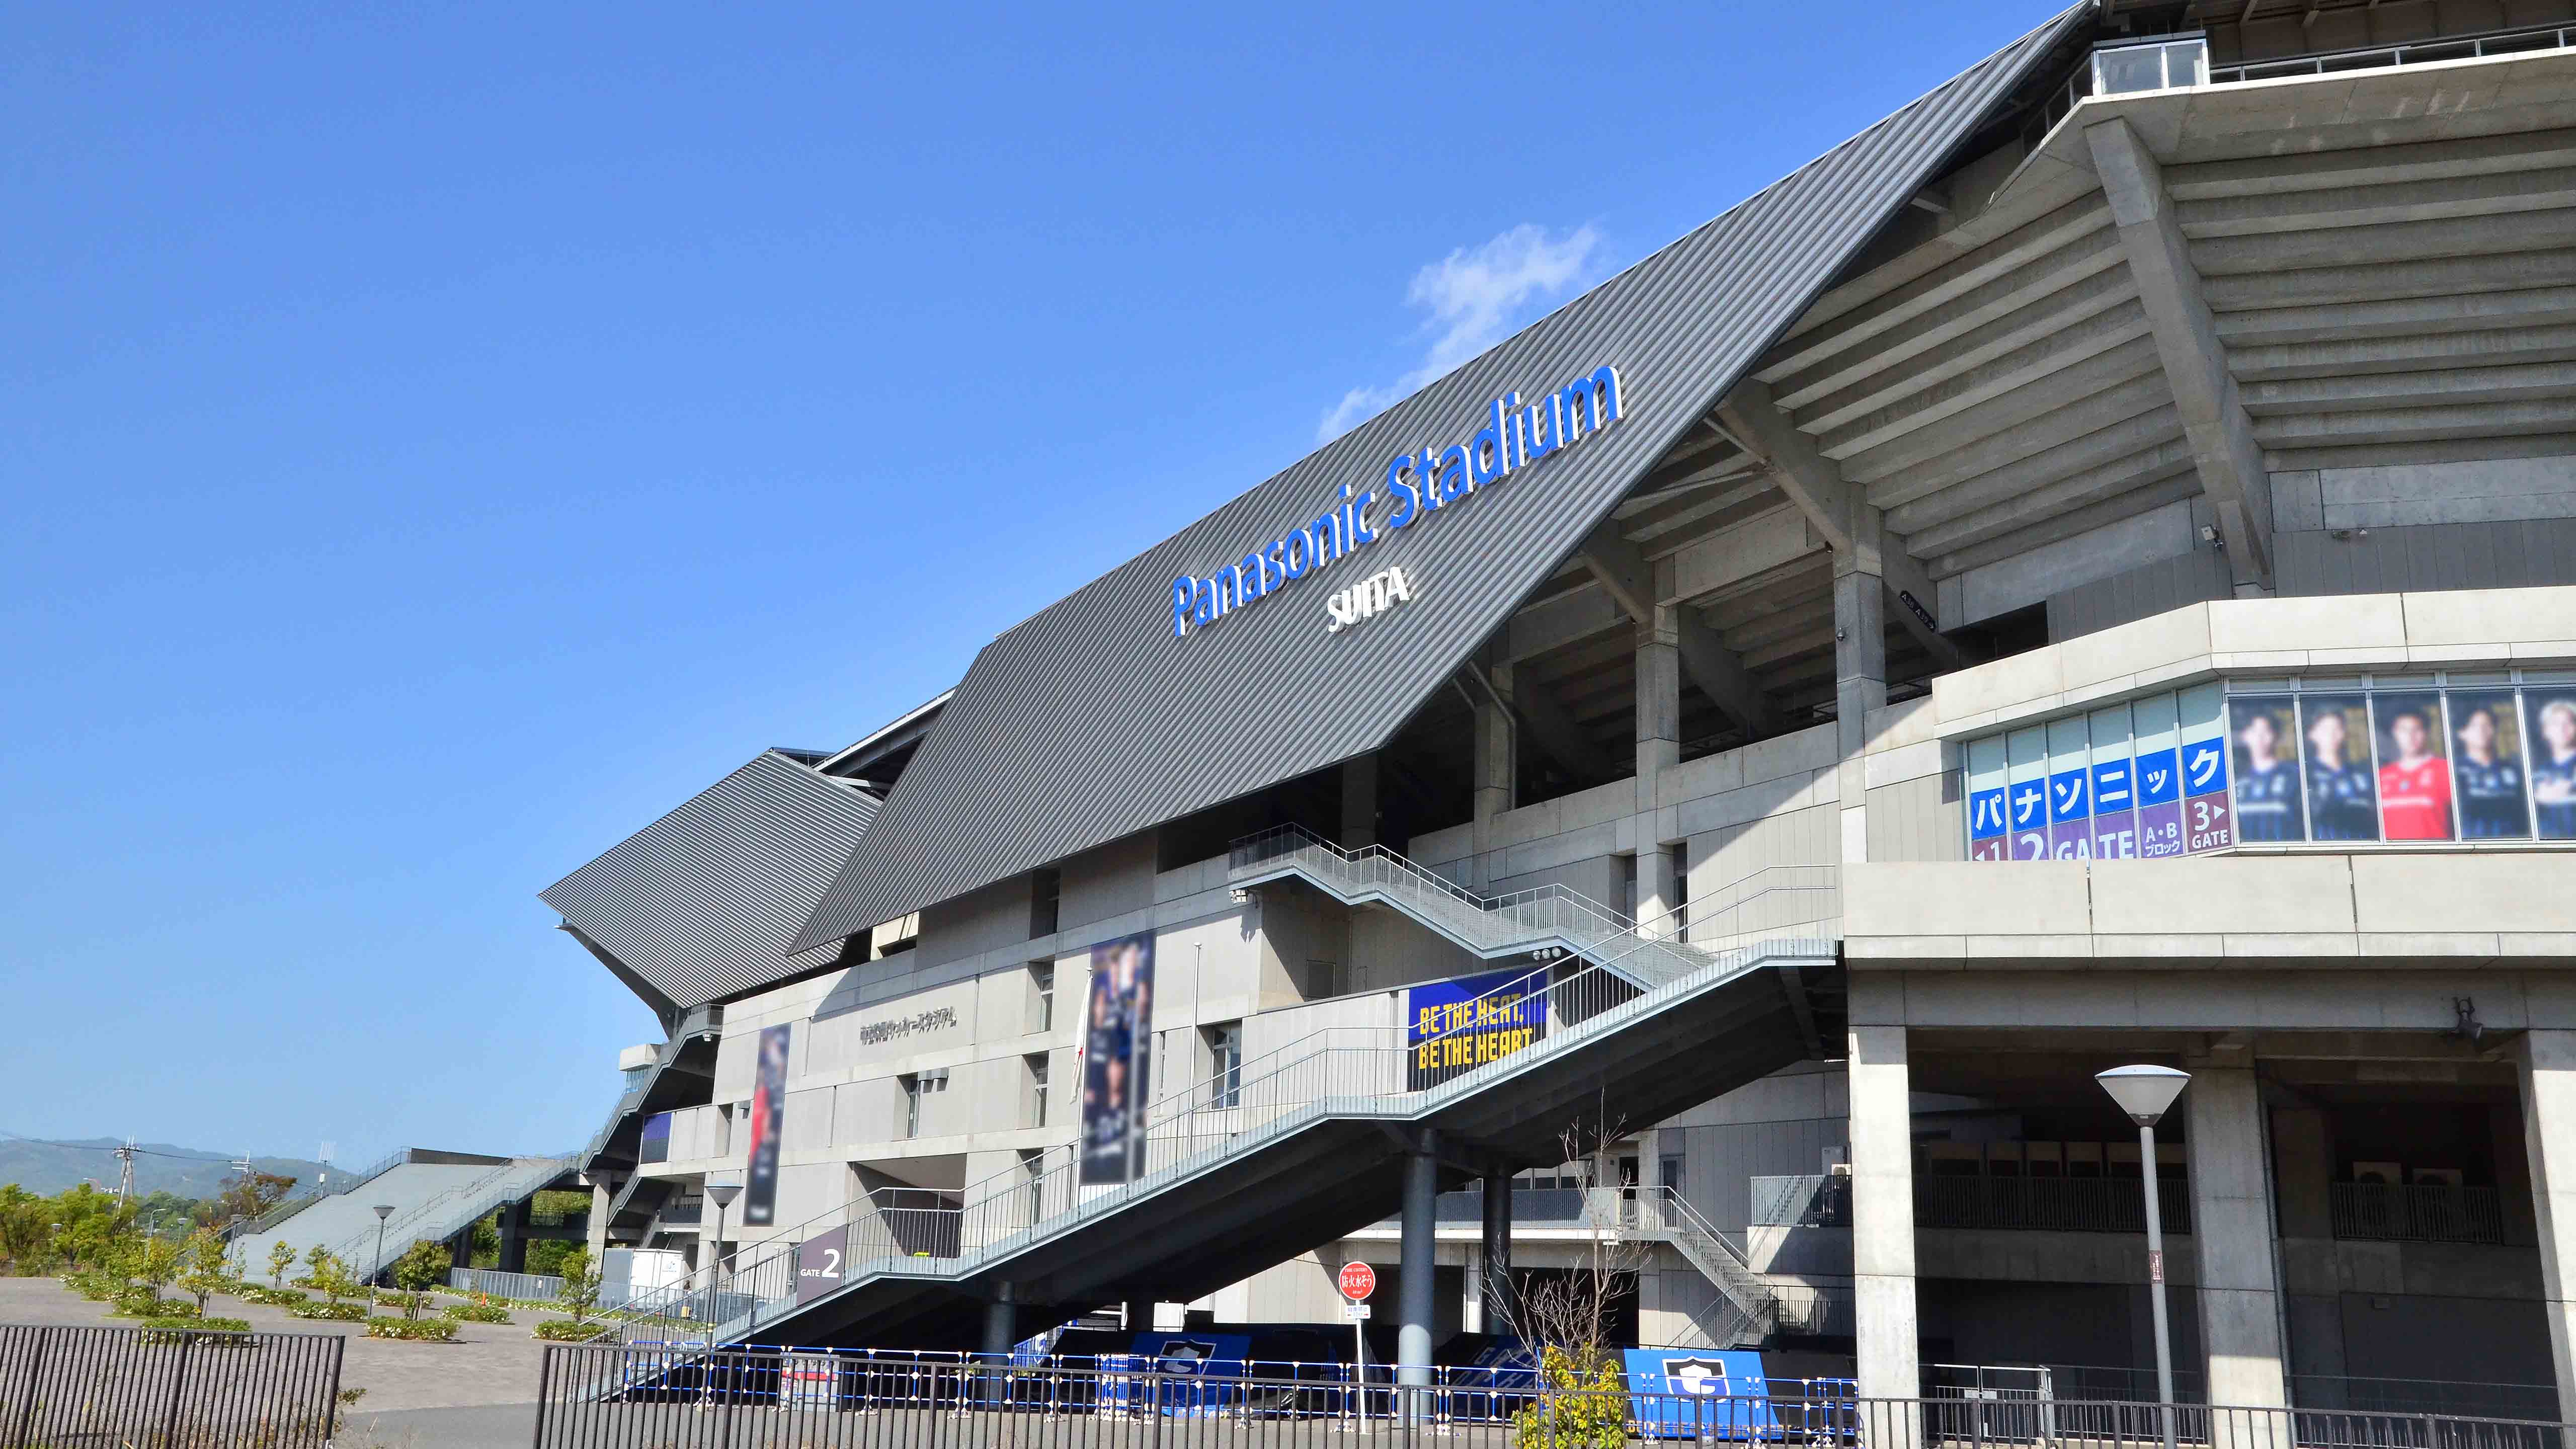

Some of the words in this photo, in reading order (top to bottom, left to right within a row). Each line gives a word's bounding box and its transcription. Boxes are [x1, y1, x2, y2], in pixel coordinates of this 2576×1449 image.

[1173, 483, 1380, 637] Panasonic
[1388, 365, 1624, 528] Stadium
[1327, 566, 1410, 633] SUITA
[1976, 748, 2220, 830] パナソニック
[2194, 801, 2210, 831] 3
[1990, 842, 2000, 861] 1
[2021, 833, 2044, 861] 2
[2056, 830, 2134, 861] GATE
[2145, 840, 2181, 857] ブロック
[2192, 829, 2228, 849] GATE
[1420, 1005, 1439, 1034] BE
[1443, 1001, 1474, 1031] THE
[1419, 1040, 1439, 1070] BE
[1443, 1036, 1473, 1067] THE
[1477, 1027, 1533, 1063] HEART
[800, 1268, 820, 1277] GATE
[822, 1248, 840, 1278] 2
